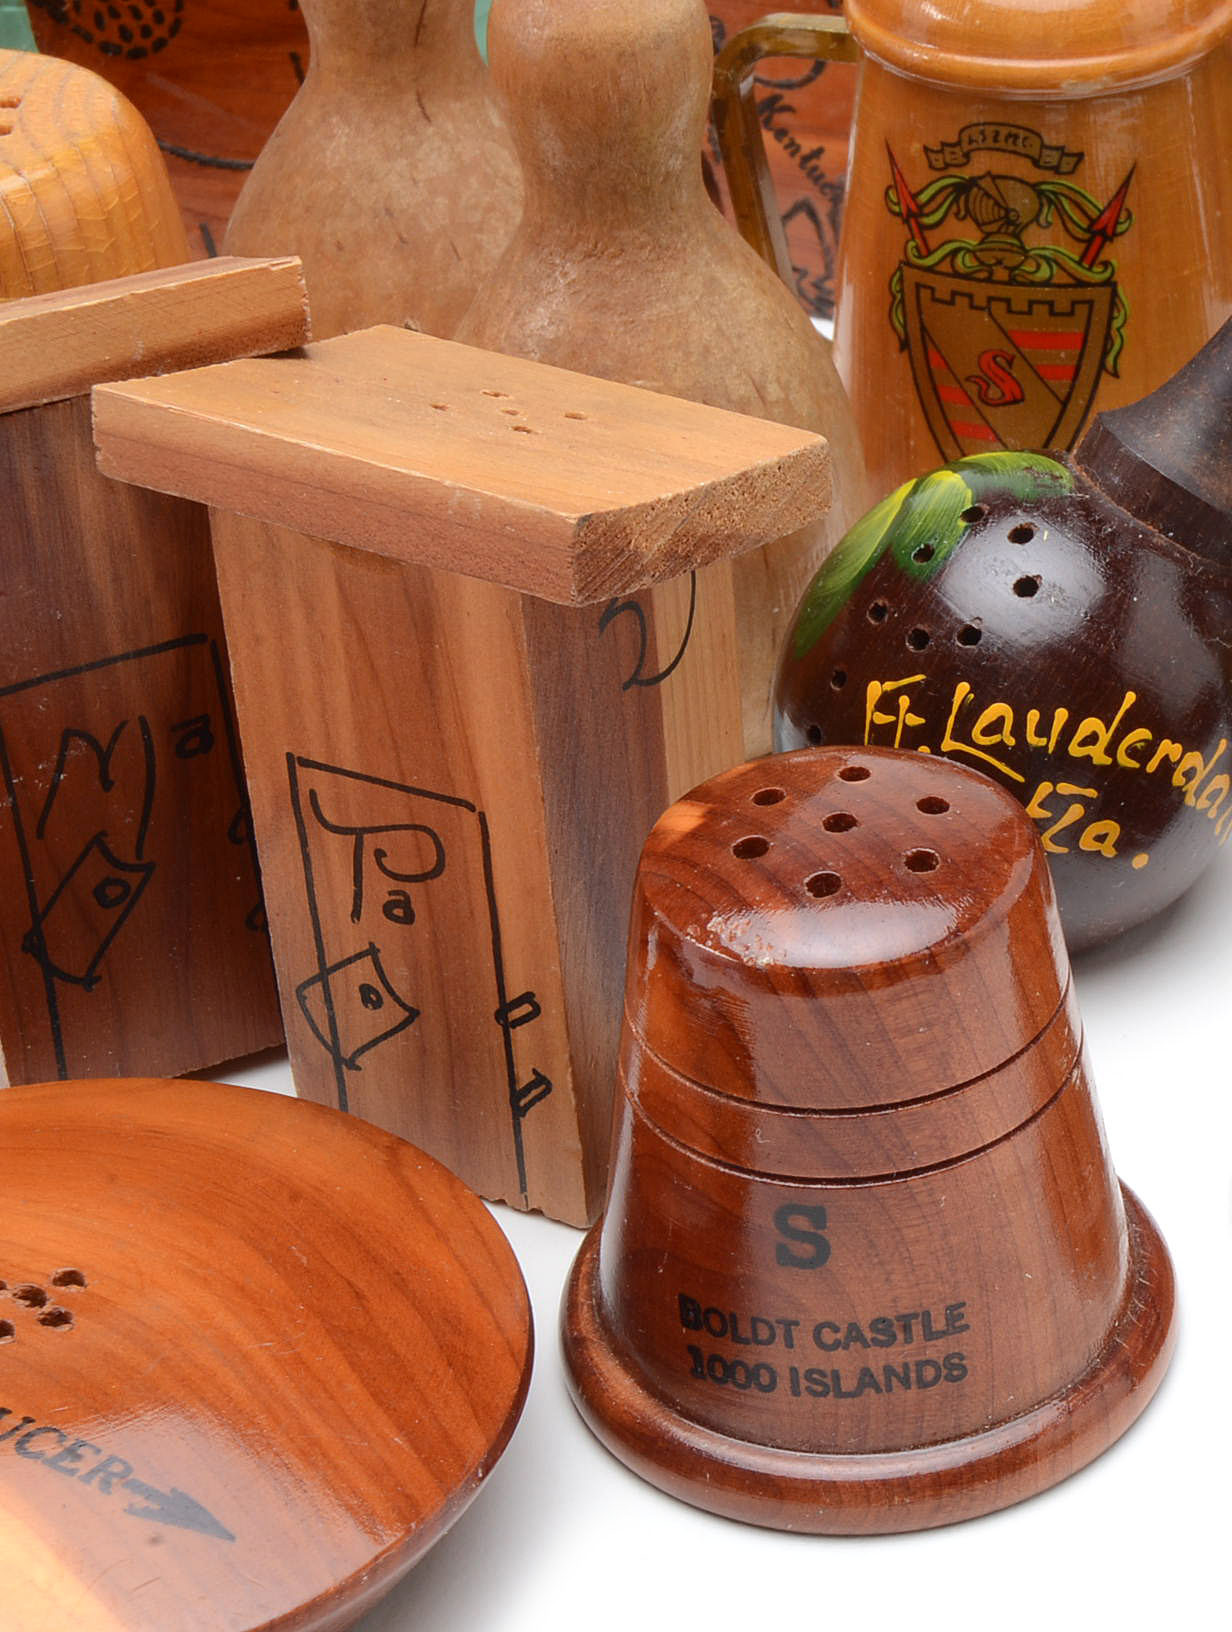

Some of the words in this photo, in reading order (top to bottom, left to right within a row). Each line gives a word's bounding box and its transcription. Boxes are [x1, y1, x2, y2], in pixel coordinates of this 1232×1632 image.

[773, 1203, 832, 1270] S
[678, 1293, 800, 1349] BOLDT
[813, 1302, 970, 1352] CASTLE
[687, 1345, 778, 1394] 1000
[789, 1353, 968, 1399] ISLANDS
